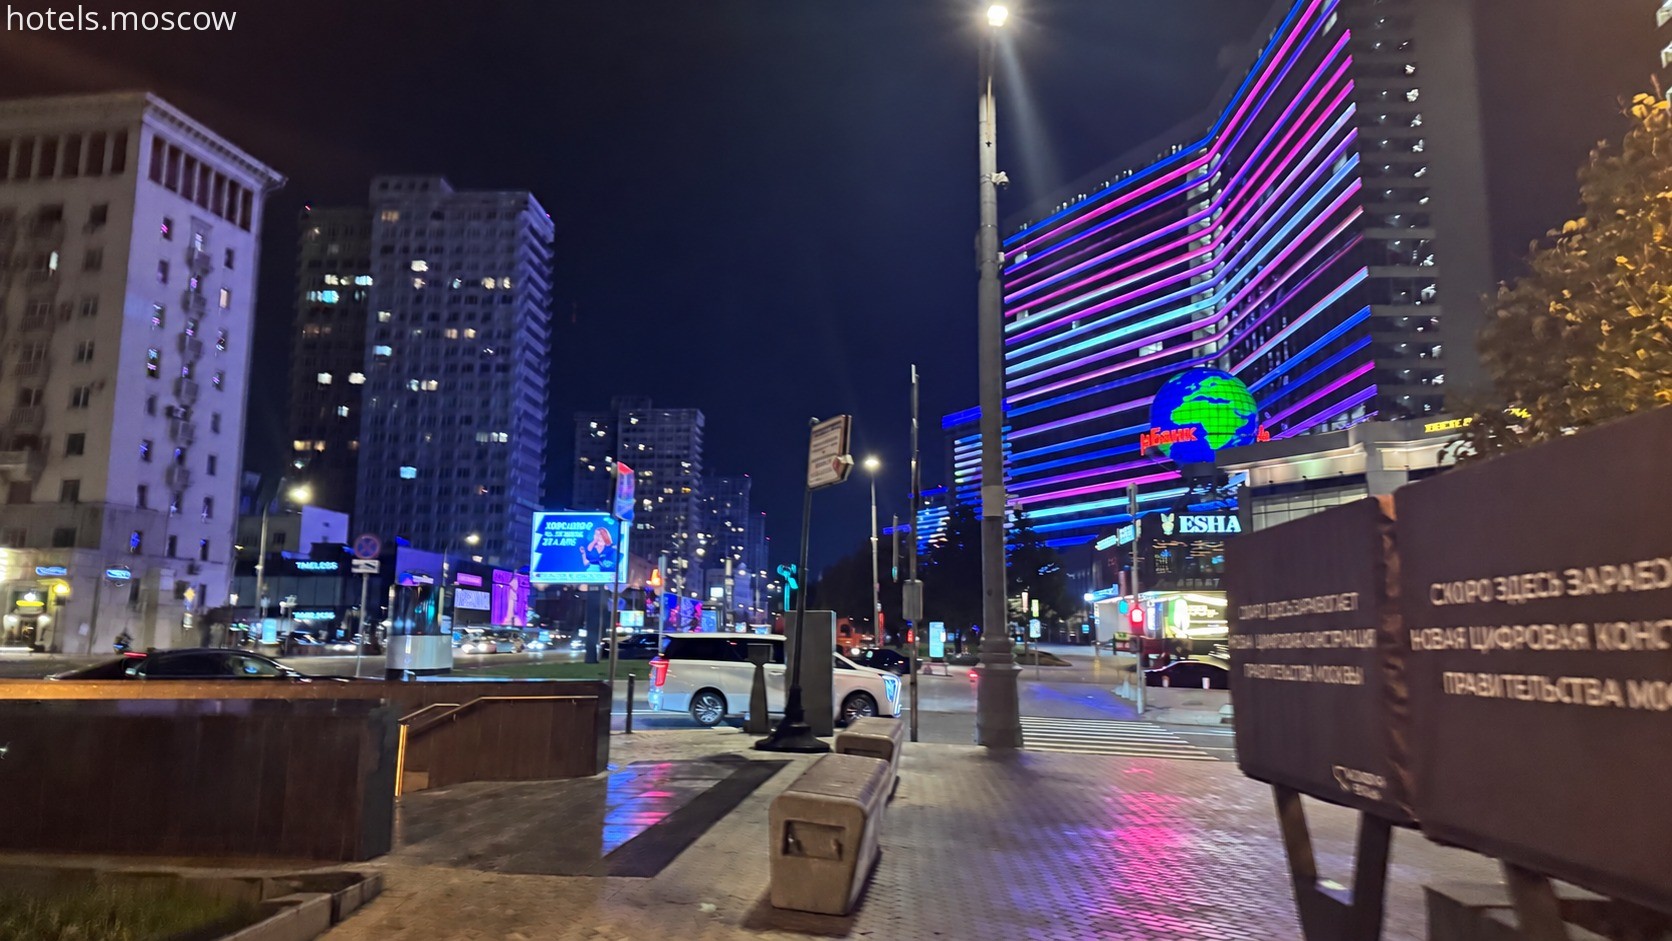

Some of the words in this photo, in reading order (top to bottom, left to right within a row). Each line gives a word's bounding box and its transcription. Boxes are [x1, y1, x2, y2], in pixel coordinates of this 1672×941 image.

[1178, 515, 1242, 533] ESHA
[1430, 578, 1493, 606] СКОРО
[1493, 571, 1564, 605] ЗДЕСЬ
[1410, 627, 1467, 650] НОВАЯ
[1469, 623, 1589, 654] ЦИФРОВАЯ
[1443, 671, 1625, 708] ПРАВИТЕЛЬСТВА
[1625, 678, 1672, 711] МО
